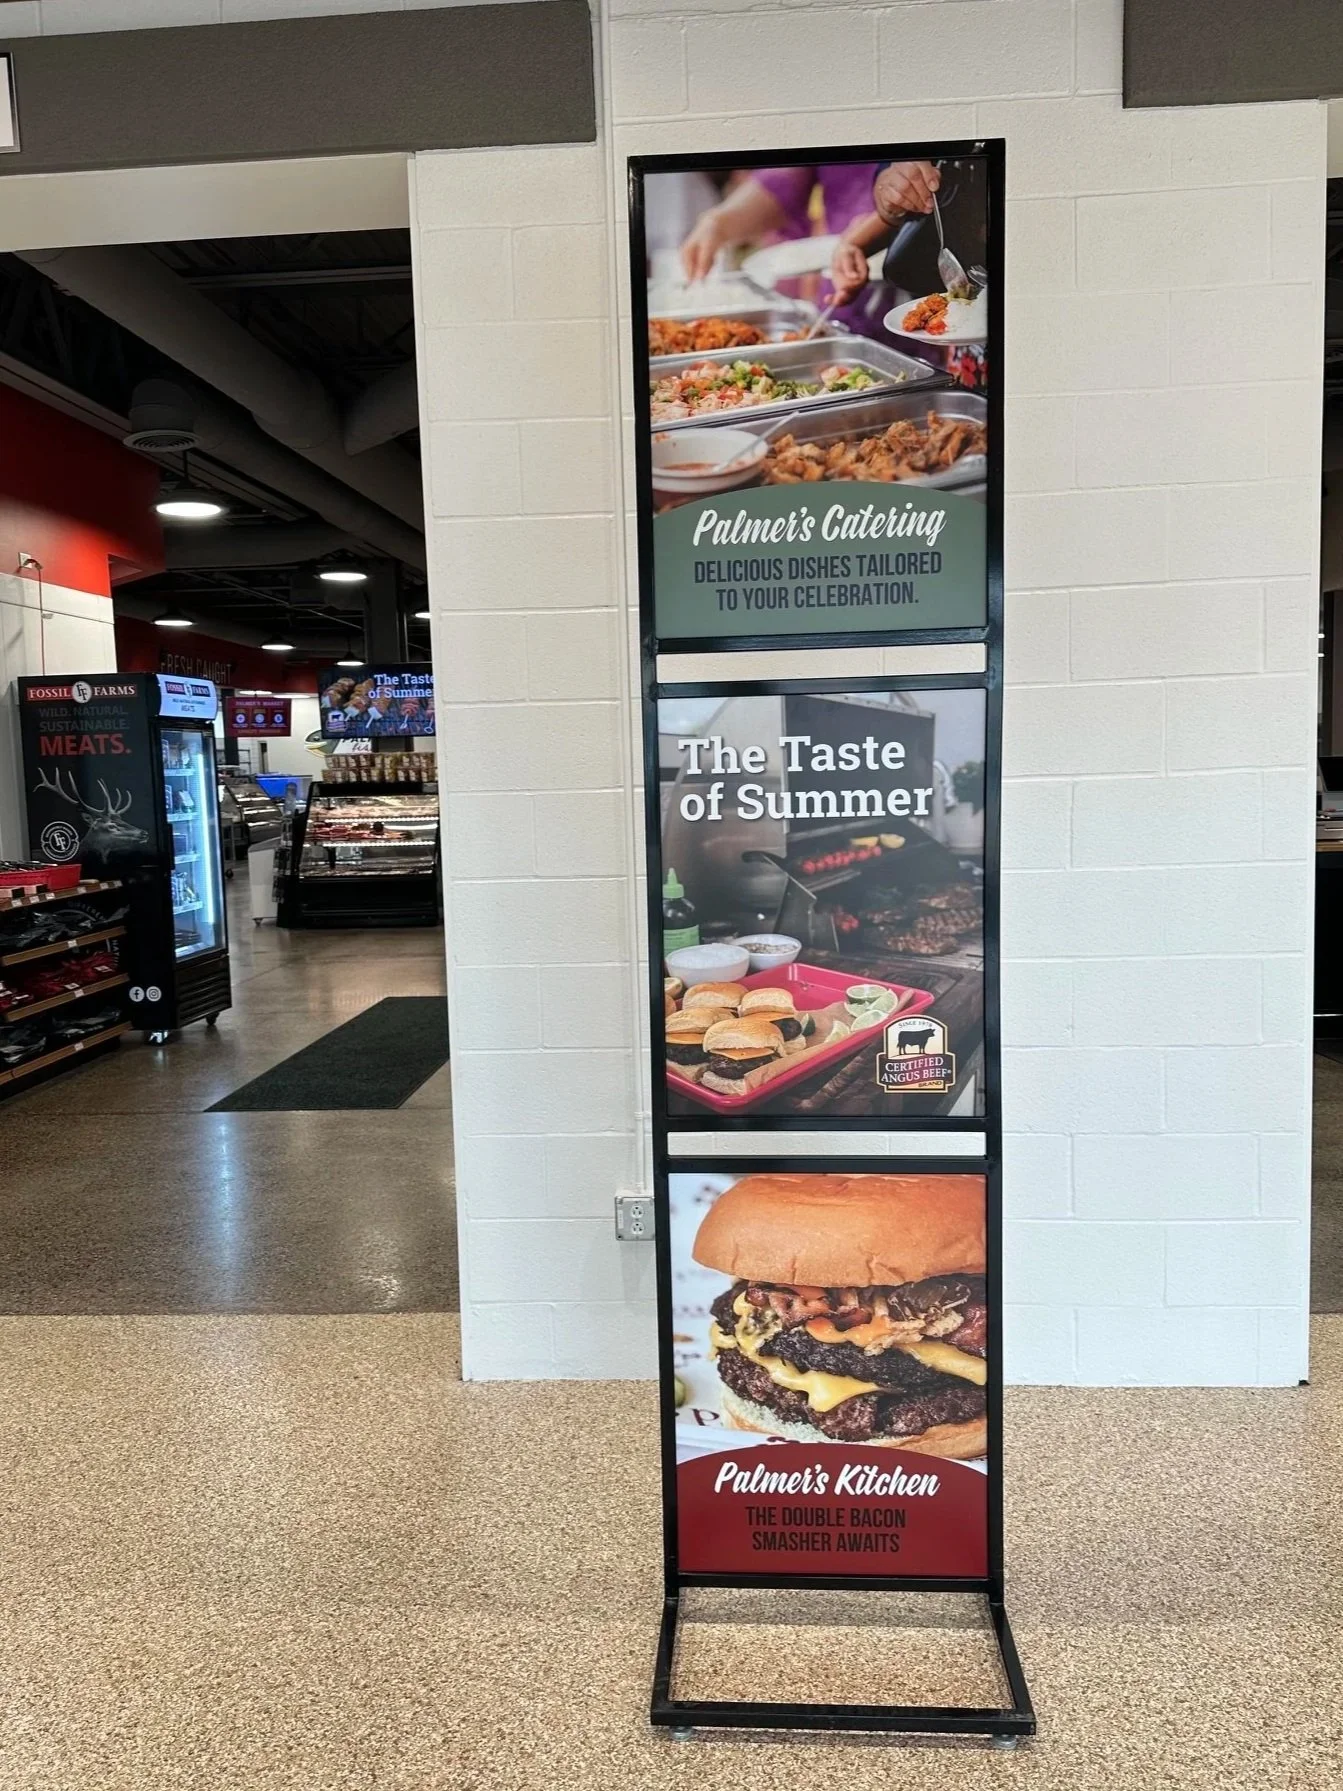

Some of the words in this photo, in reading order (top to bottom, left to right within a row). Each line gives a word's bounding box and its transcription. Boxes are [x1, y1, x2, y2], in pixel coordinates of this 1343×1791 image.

[693, 506, 816, 546] Palmer's
[821, 502, 948, 547] Catering
[694, 558, 784, 584] DELICIOUS
[788, 555, 851, 581] DISHES
[855, 551, 942, 577] TAILORED
[716, 588, 738, 611] TO
[742, 586, 789, 610] YOUR
[794, 581, 920, 608] CELEBRATION.
[374, 674, 399, 685] The
[401, 674, 434, 685] Taste
[30, 688, 71, 699] FOSSIL
[93, 685, 136, 696] FARMS
[368, 688, 382, 699] of
[384, 688, 434, 698] Summe
[40, 733, 132, 756] MEATS.
[678, 736, 766, 775] The
[779, 736, 906, 772] Taste
[680, 783, 724, 821] of
[737, 784, 933, 820] Summer
[885, 1056, 944, 1072] CERTIFIED
[881, 1070, 920, 1083] ANGUS
[714, 1461, 830, 1495] Palmer's
[833, 1463, 941, 1497] Kitchen
[745, 1506, 777, 1526] THE
[782, 1507, 845, 1527] DOUBLE
[850, 1508, 906, 1529] BACON
[752, 1531, 831, 1552] SMASHER
[836, 1533, 900, 1553] AWAITS
